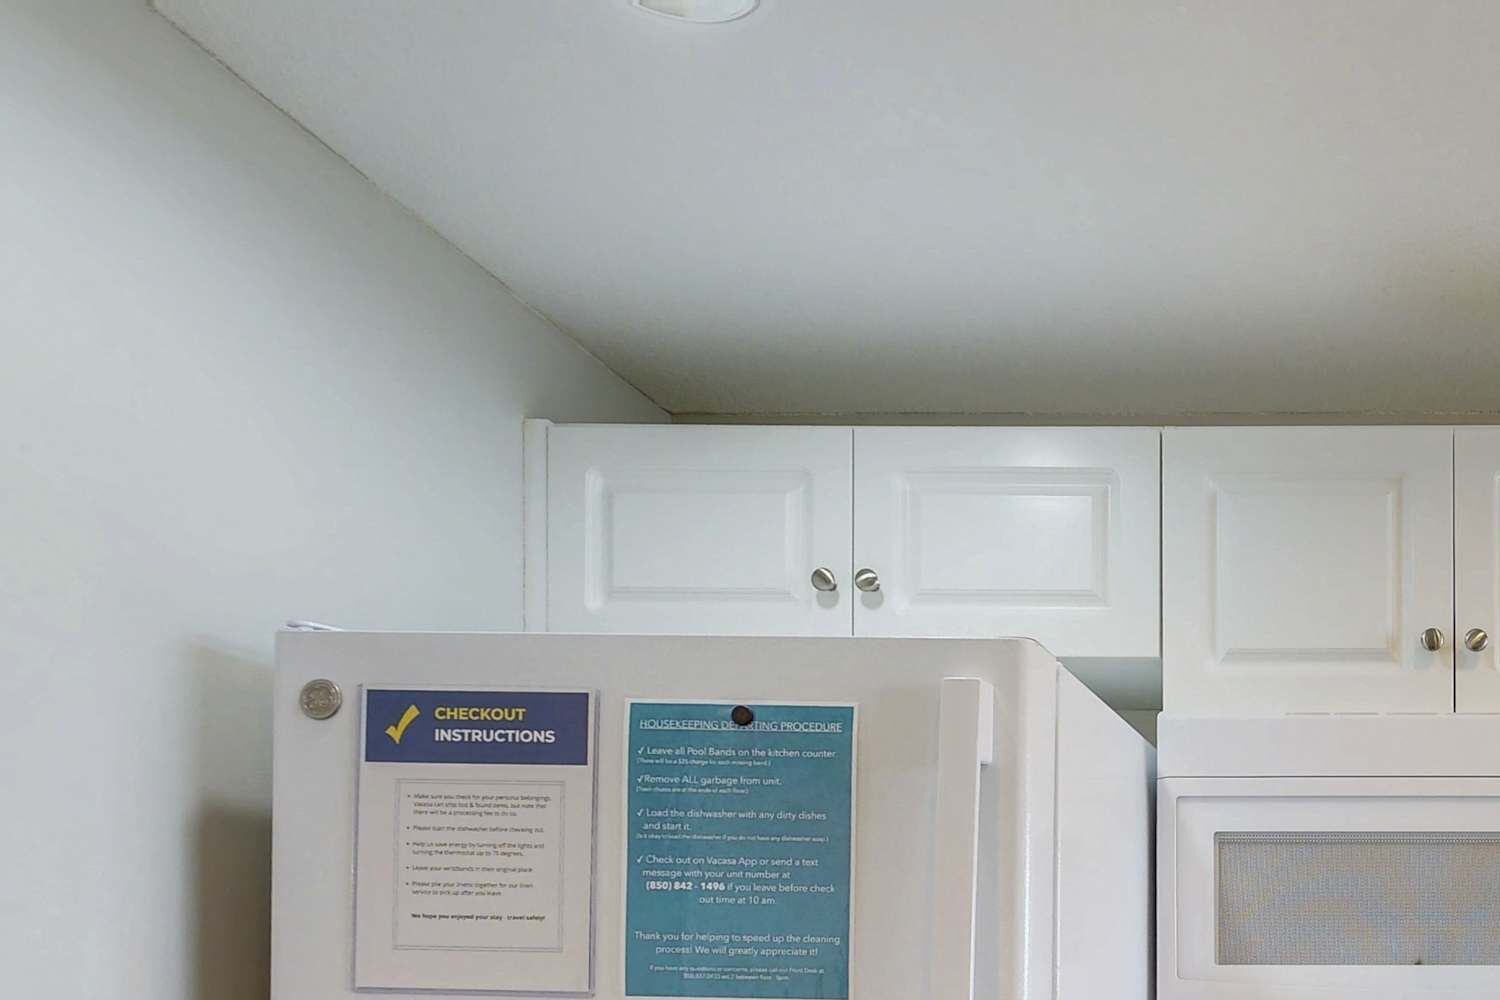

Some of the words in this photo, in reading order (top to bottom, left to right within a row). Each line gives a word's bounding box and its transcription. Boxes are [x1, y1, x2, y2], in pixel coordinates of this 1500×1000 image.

[434, 708, 526, 720] CHECKOUT
[640, 720, 718, 730] HOUSEKEEPING
[781, 722, 842, 732] PROCEDURE
[434, 728, 556, 743] INSTRUCTIONS
[647, 746, 672, 755] Leave
[675, 746, 685, 755] all
[688, 747, 706, 756] Pool
[708, 748, 736, 756] Bands
[752, 748, 766, 756] the
[768, 748, 800, 757] kitchen
[644, 774, 680, 784] Remove
[682, 776, 698, 784] ALL
[700, 776, 738, 786] garbage
[740, 776, 760, 785] from
[646, 808, 668, 816] Load
[670, 808, 685, 817] the
[687, 808, 736, 818] dishwasher
[738, 810, 757, 818] with
[758, 812, 774, 820] any
[776, 812, 796, 820] dirty
[798, 812, 826, 820] dishes
[646, 856, 674, 864] Check
[706, 856, 736, 864] Vacasa
[738, 858, 758, 866] App
[771, 858, 792, 866] send
[642, 870, 682, 878] message
[704, 871, 724, 880] your
[745, 870, 780, 878] number
[646, 881, 672, 890] (850)
[674, 882, 692, 890] 842
[701, 882, 726, 890] 1496
[727, 882, 732, 890] if
[734, 884, 752, 893] you
[754, 884, 777, 892] leave
[779, 884, 808, 892] before
[810, 884, 834, 893] check
[716, 896, 736, 904] time
[750, 896, 760, 904] 10
[634, 931, 660, 940] Thank
[662, 934, 680, 942] you
[681, 932, 694, 940] for
[696, 932, 730, 943] helping
[742, 934, 770, 943] speed
[772, 936, 784, 944] up
[786, 934, 801, 942] the
[803, 934, 840, 946] cleaning
[656, 946, 692, 954] process!
[695, 946, 710, 954] We
[712, 946, 726, 954] will
[728, 947, 758, 957] greatly
[760, 949, 807, 958] appreciate
[810, 948, 818, 956] it!
